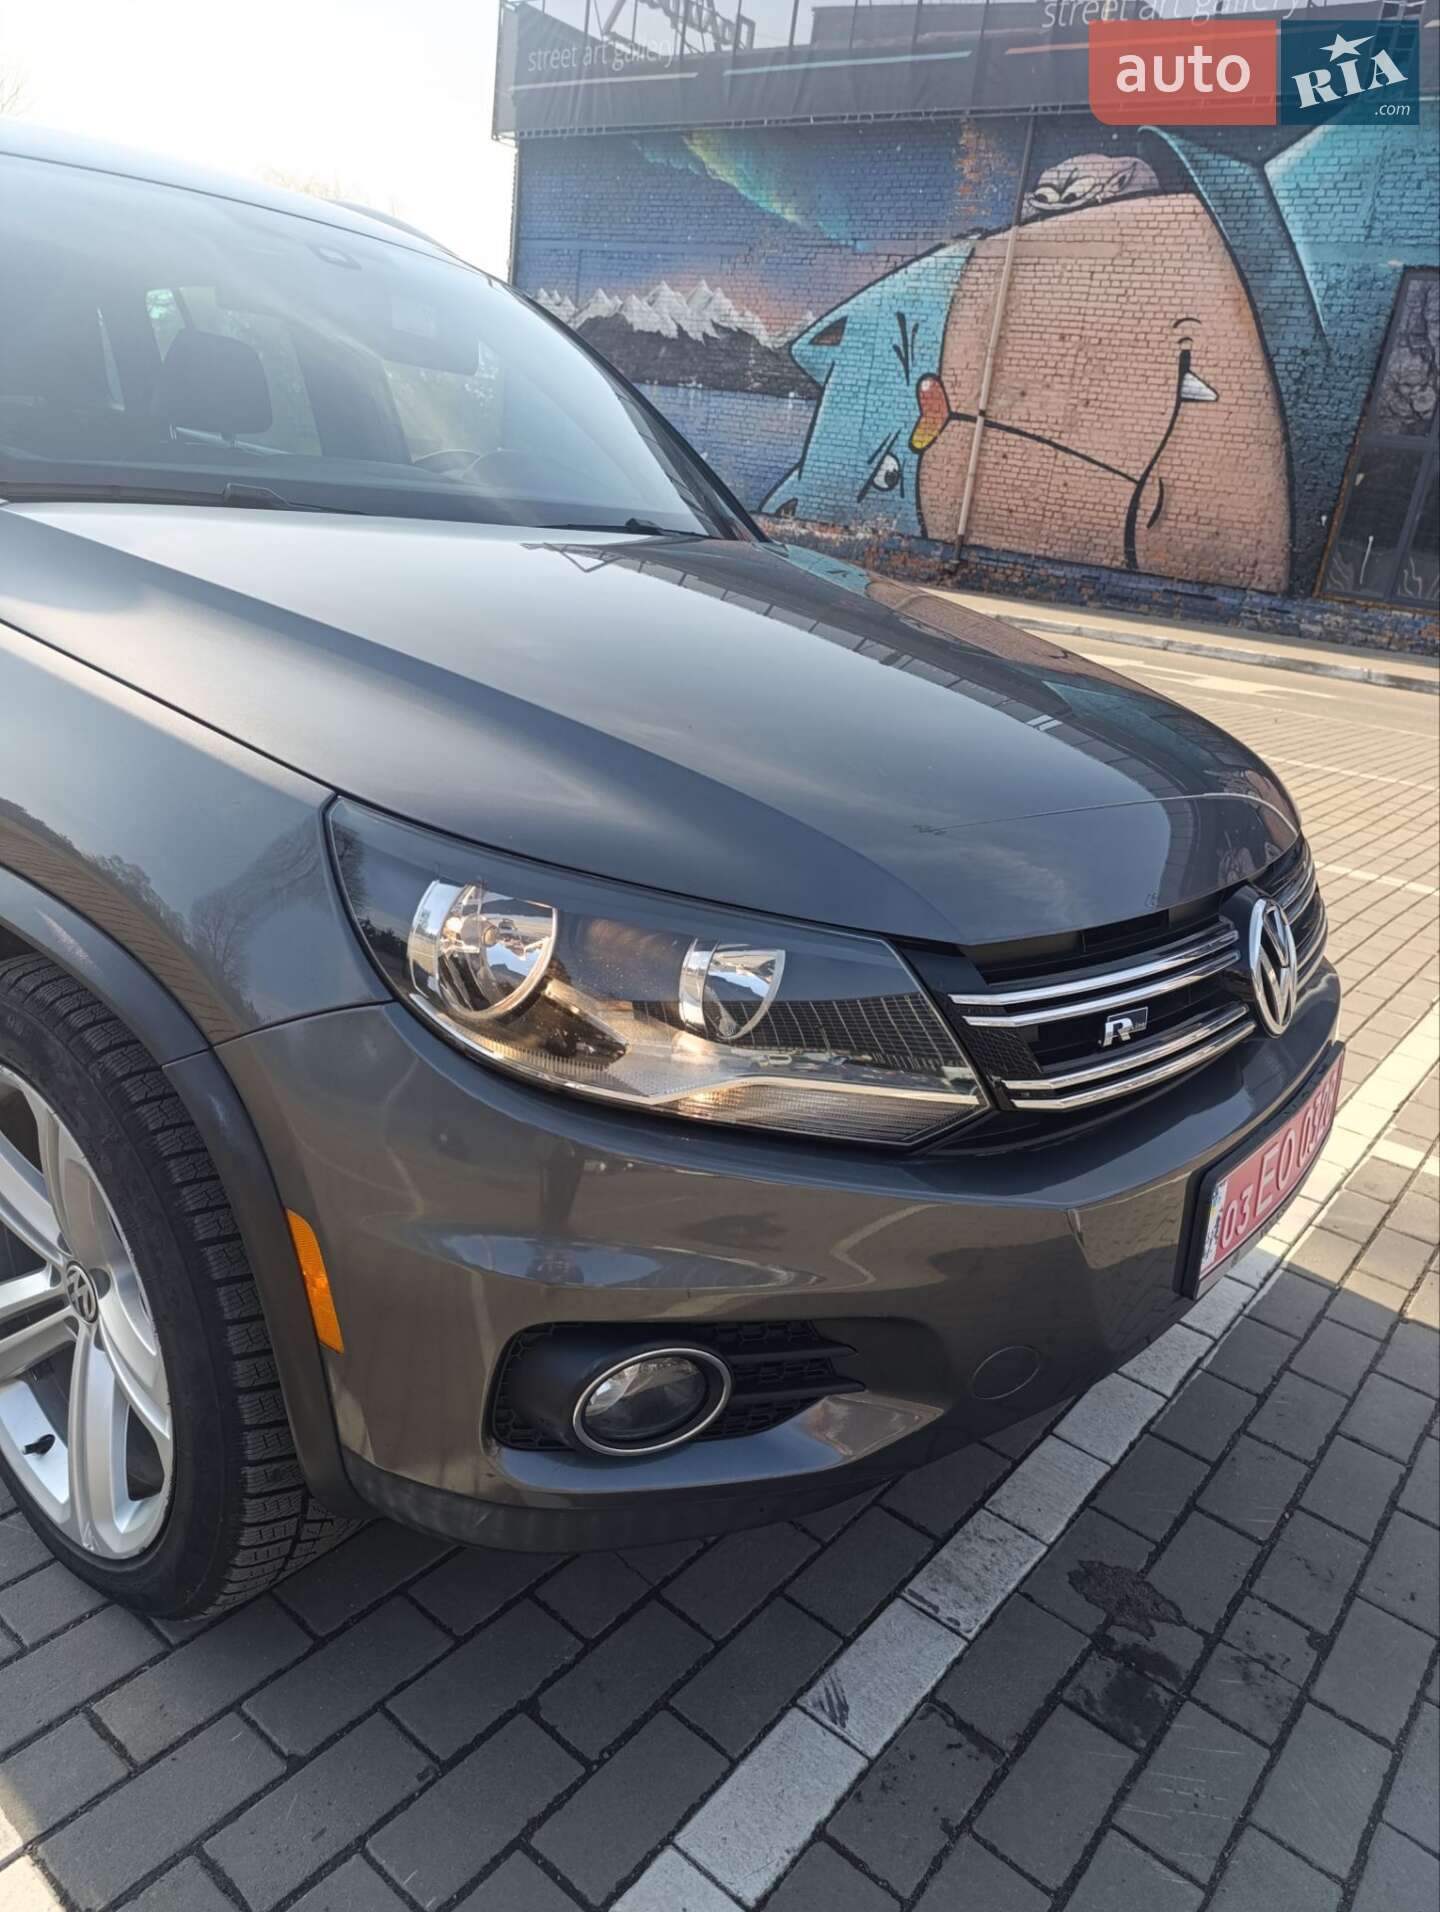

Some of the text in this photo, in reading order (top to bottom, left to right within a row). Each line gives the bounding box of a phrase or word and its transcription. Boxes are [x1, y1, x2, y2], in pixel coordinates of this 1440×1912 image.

[1042, 0, 1128, 28] street
[527, 45, 578, 72] street
[583, 41, 608, 66] art
[1103, 1017, 1134, 1047] R
[1221, 1184, 1254, 1249] 03
